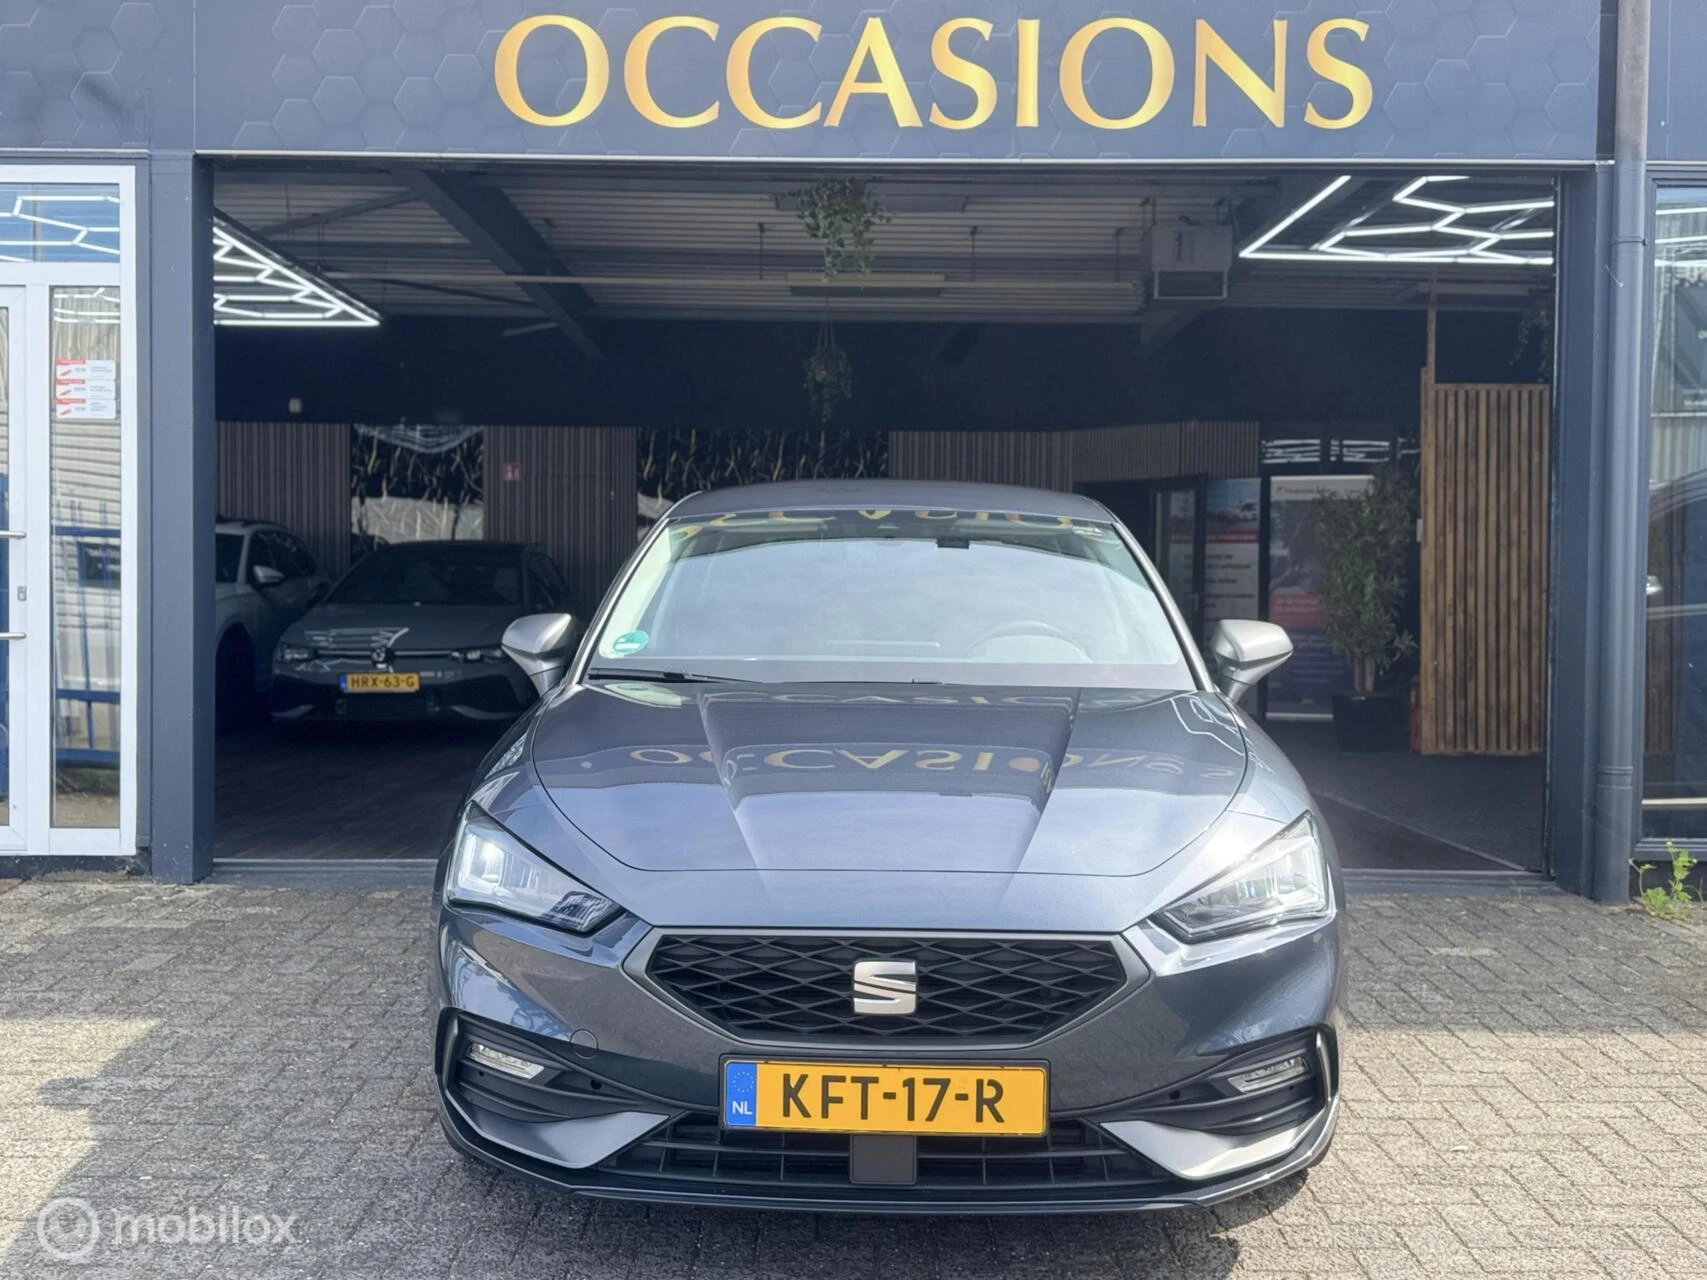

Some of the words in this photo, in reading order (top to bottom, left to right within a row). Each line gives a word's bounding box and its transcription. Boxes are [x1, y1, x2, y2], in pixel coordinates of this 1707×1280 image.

[494, 14, 1374, 130] OCCASIONS
[351, 675, 415, 688] HRX-63-G
[732, 1101, 753, 1115] NL
[782, 1073, 1005, 1123] KFT-17-R
